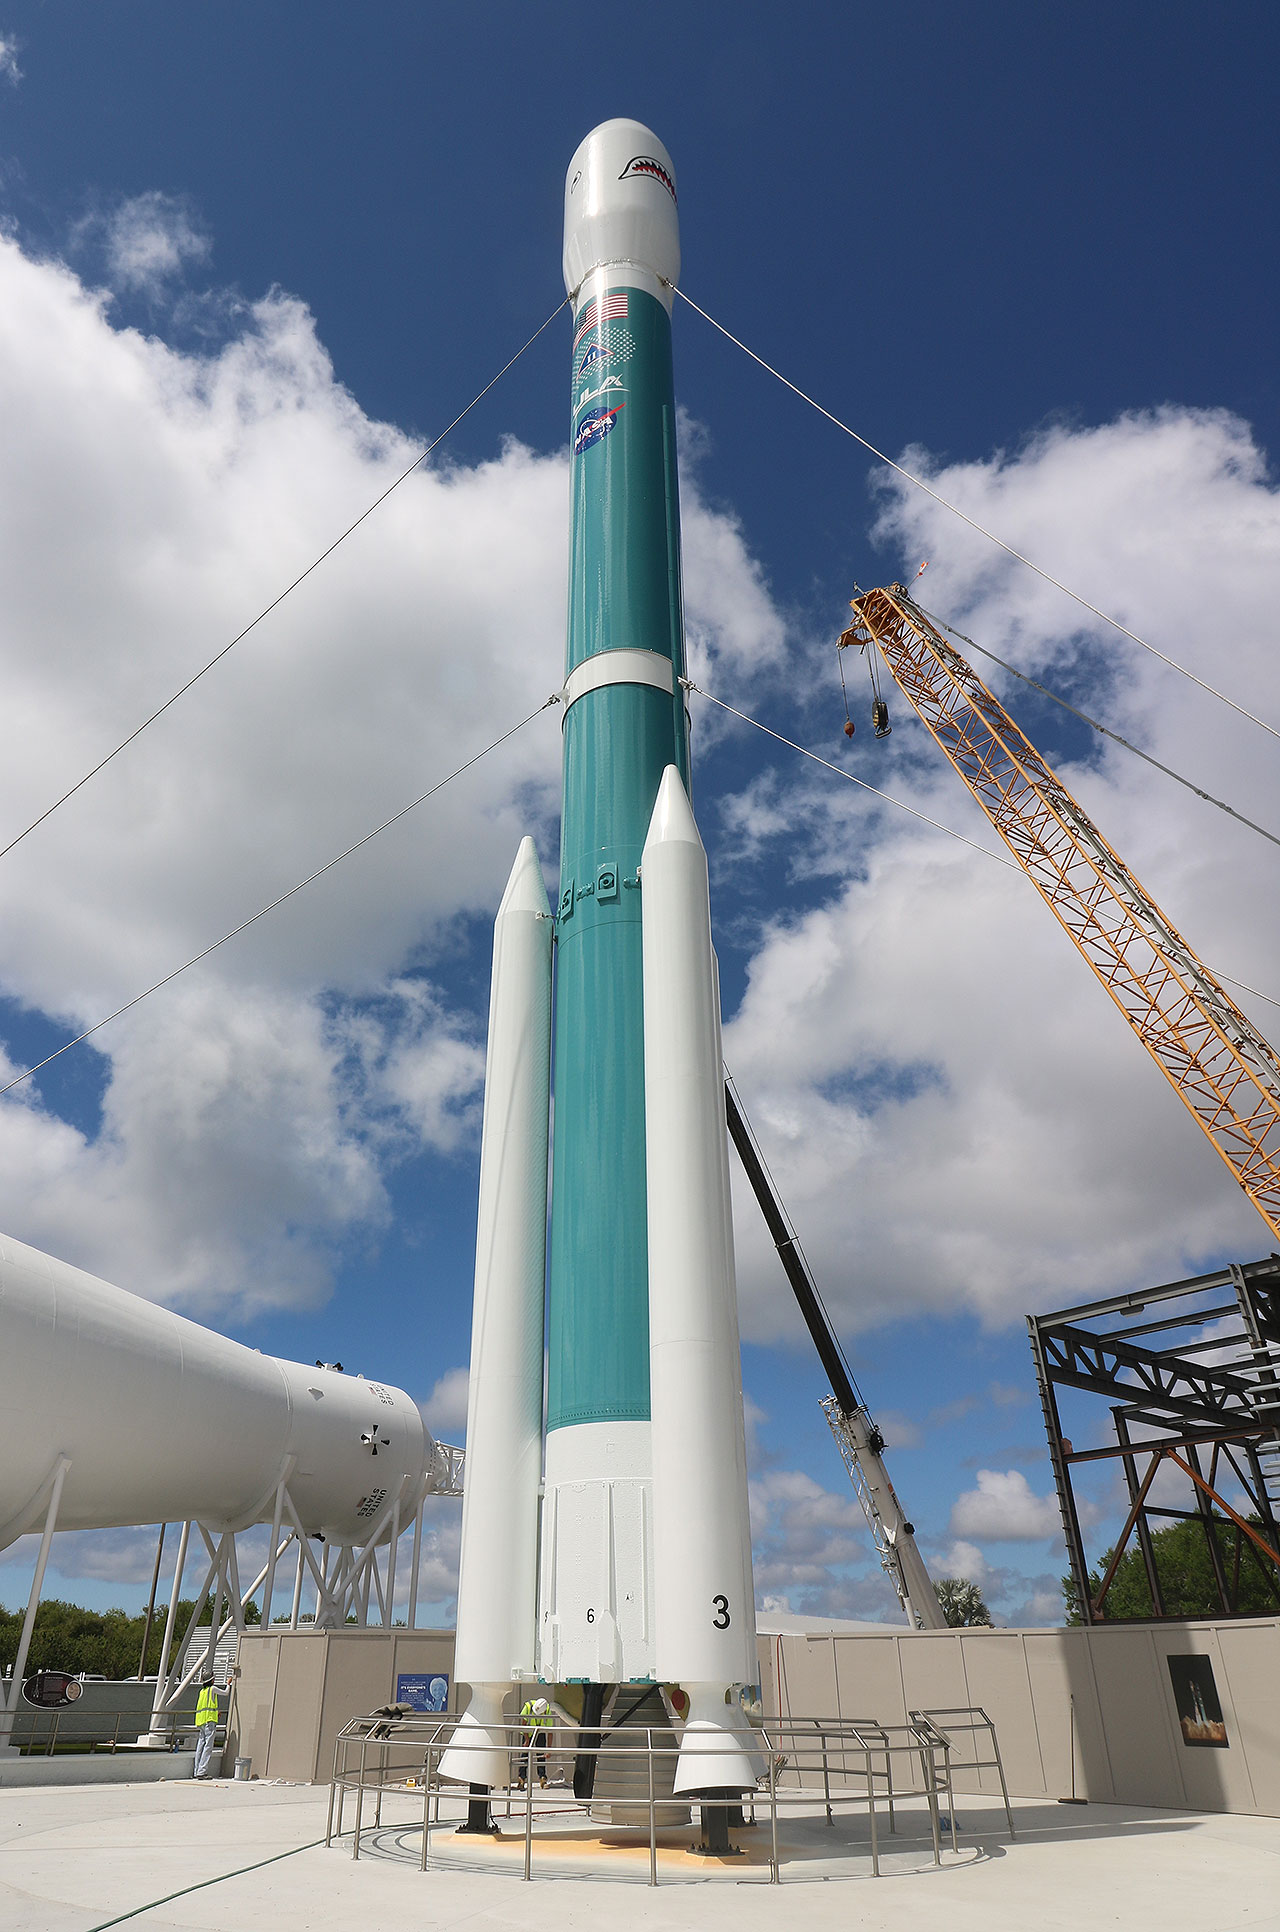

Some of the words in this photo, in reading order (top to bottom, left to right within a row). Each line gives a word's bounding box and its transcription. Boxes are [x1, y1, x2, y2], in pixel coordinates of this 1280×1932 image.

[574, 415, 614, 449] NASA
[357, 1488, 380, 1516] STATES
[365, 1489, 387, 1517] UNITED
[586, 1608, 595, 1623] 6
[712, 1594, 731, 1630] 3
